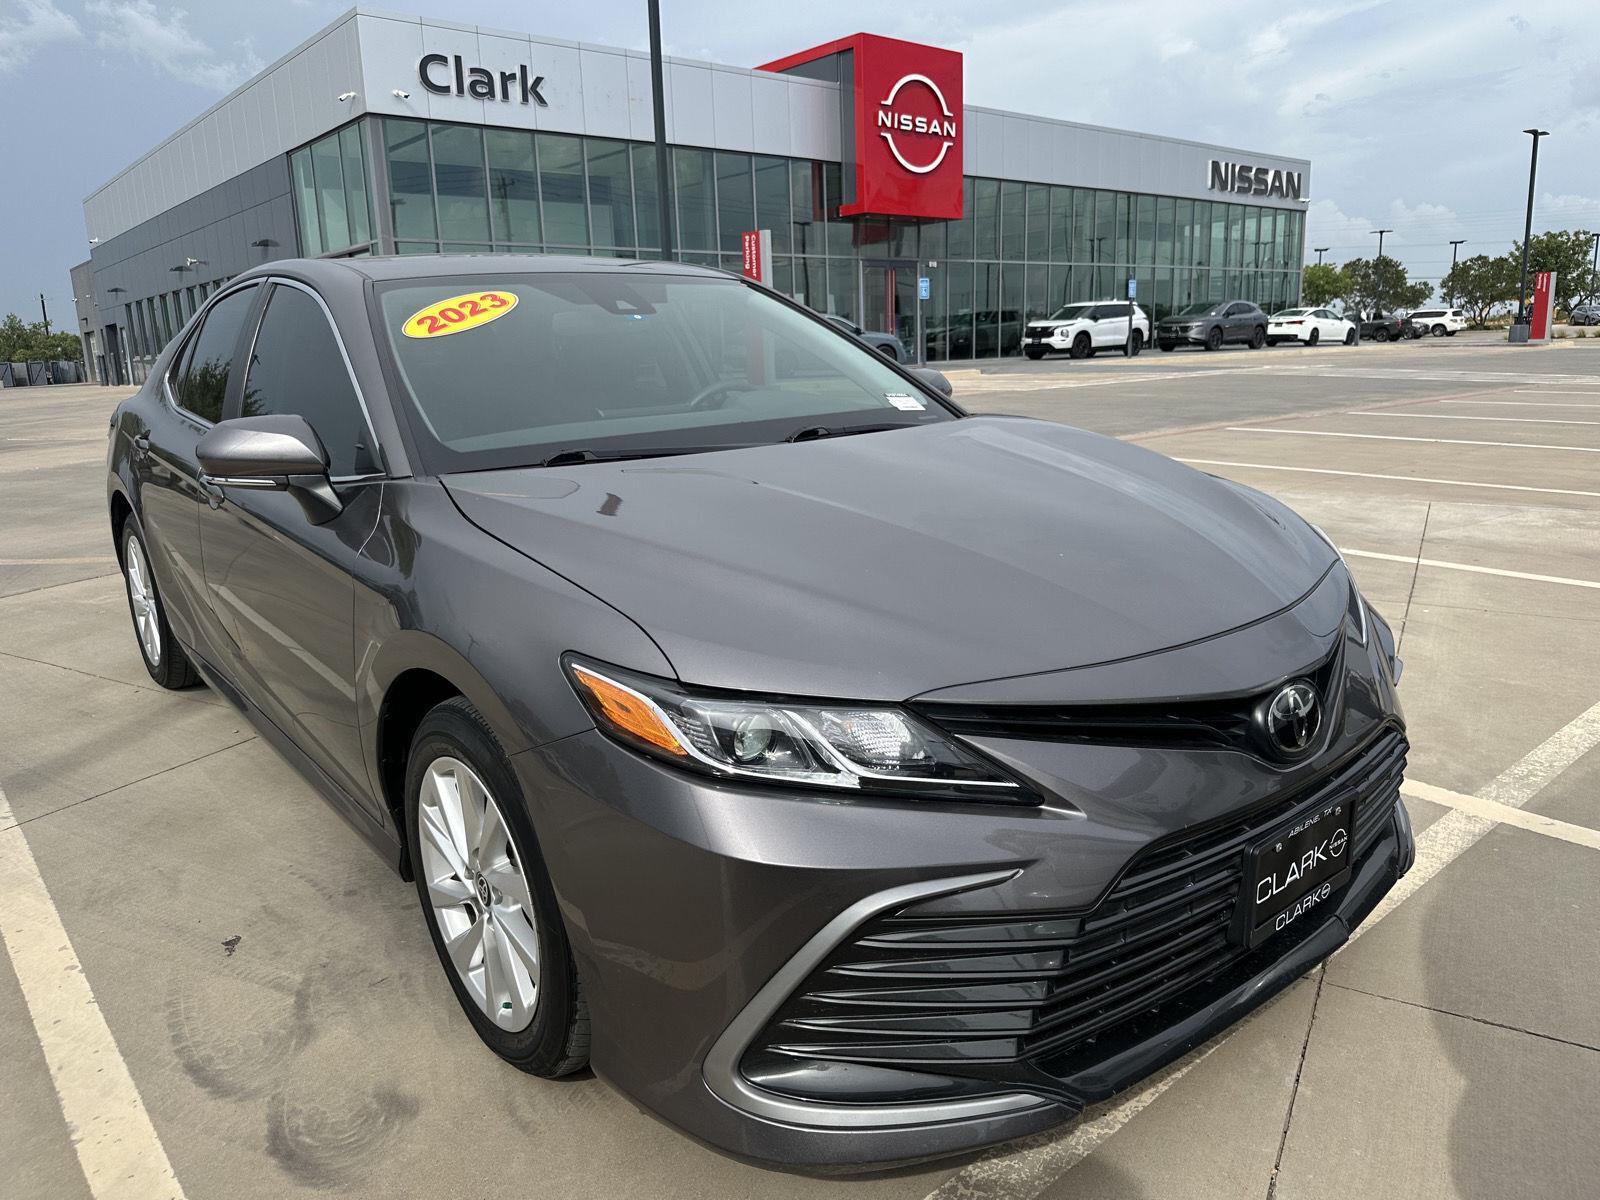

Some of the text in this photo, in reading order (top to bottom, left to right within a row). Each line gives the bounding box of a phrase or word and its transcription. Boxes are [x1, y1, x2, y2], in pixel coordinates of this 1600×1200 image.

[418, 53, 548, 107] Clark
[878, 110, 956, 138] NISSAN
[1208, 160, 1302, 199] NISSAN
[416, 293, 510, 335] 2023
[1256, 839, 1328, 905] CLARK
[1275, 888, 1321, 931] CLARK
